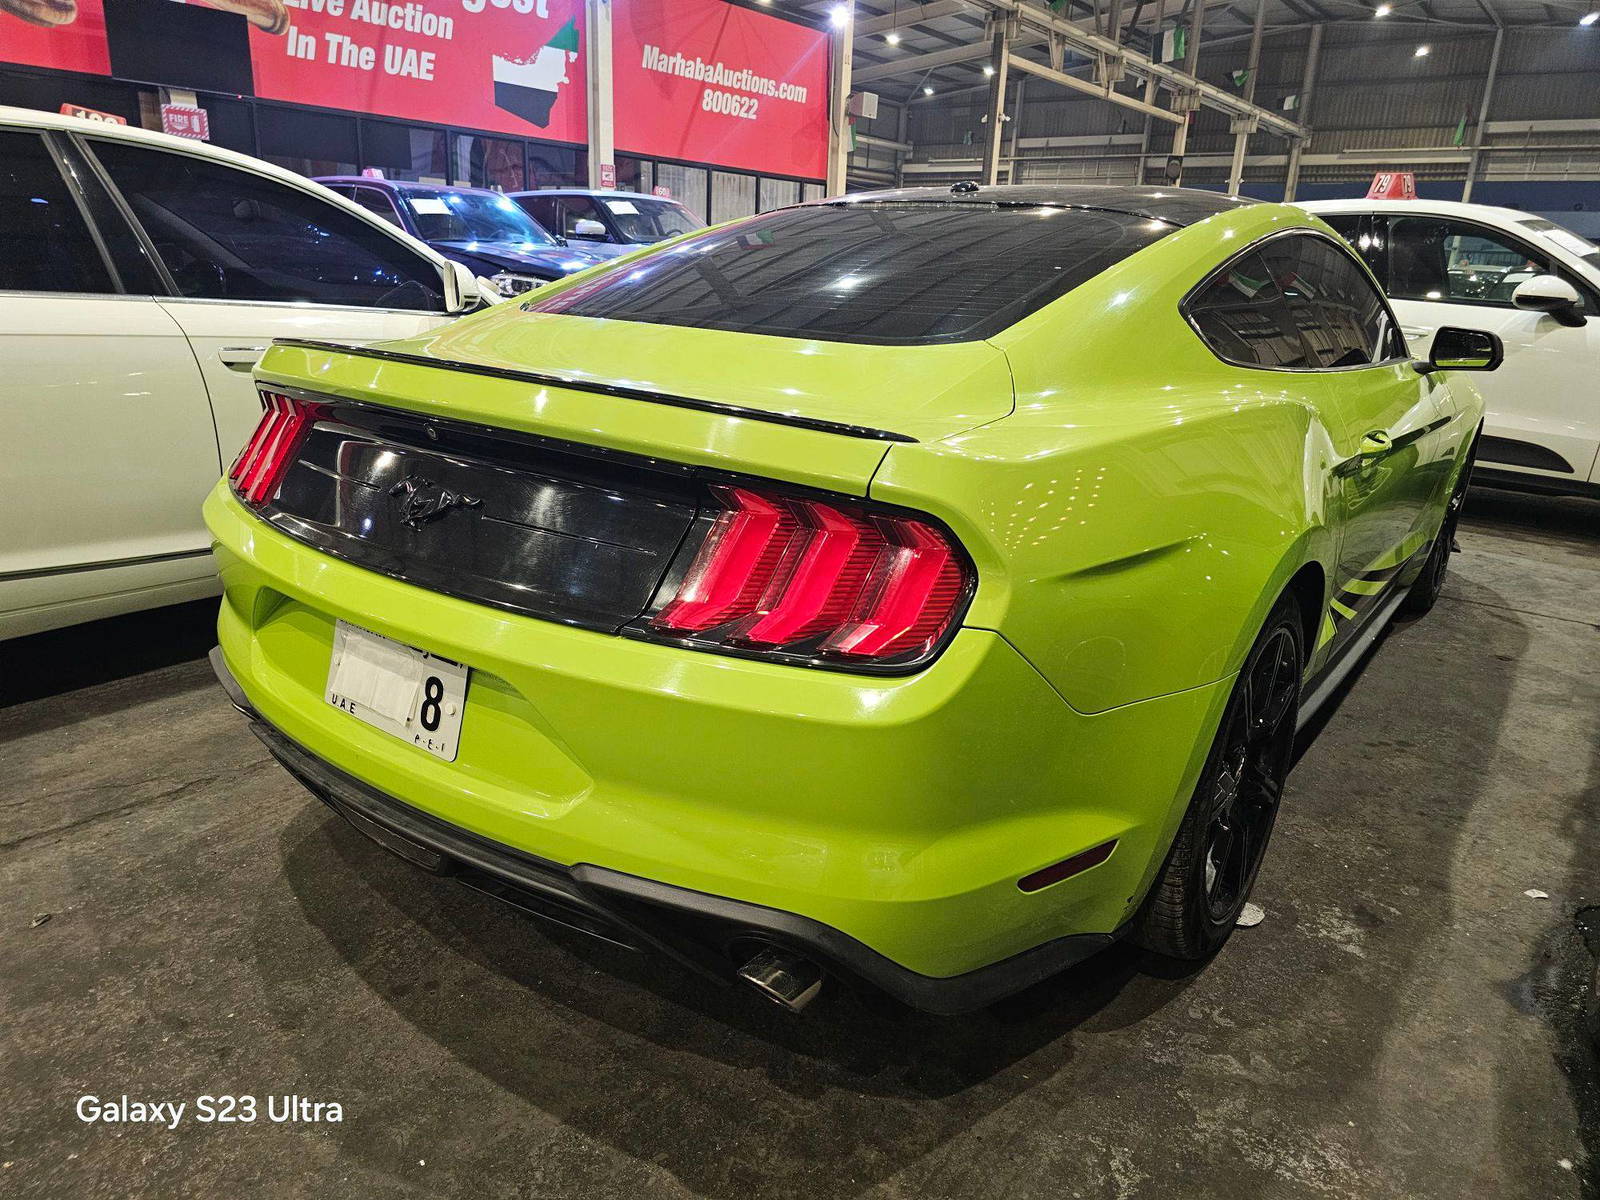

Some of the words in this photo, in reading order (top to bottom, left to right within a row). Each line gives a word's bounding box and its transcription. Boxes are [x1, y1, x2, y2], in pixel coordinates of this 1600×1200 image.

[350, 0, 454, 40] Auction
[286, 26, 316, 60] In
[325, 32, 376, 71] The
[384, 44, 436, 81] UAE
[642, 44, 808, 104] MarhabaAuctions.com
[168, 113, 189, 123] FIRE
[702, 88, 759, 120] 800622
[1373, 174, 1391, 193] 79
[420, 676, 444, 732] 8
